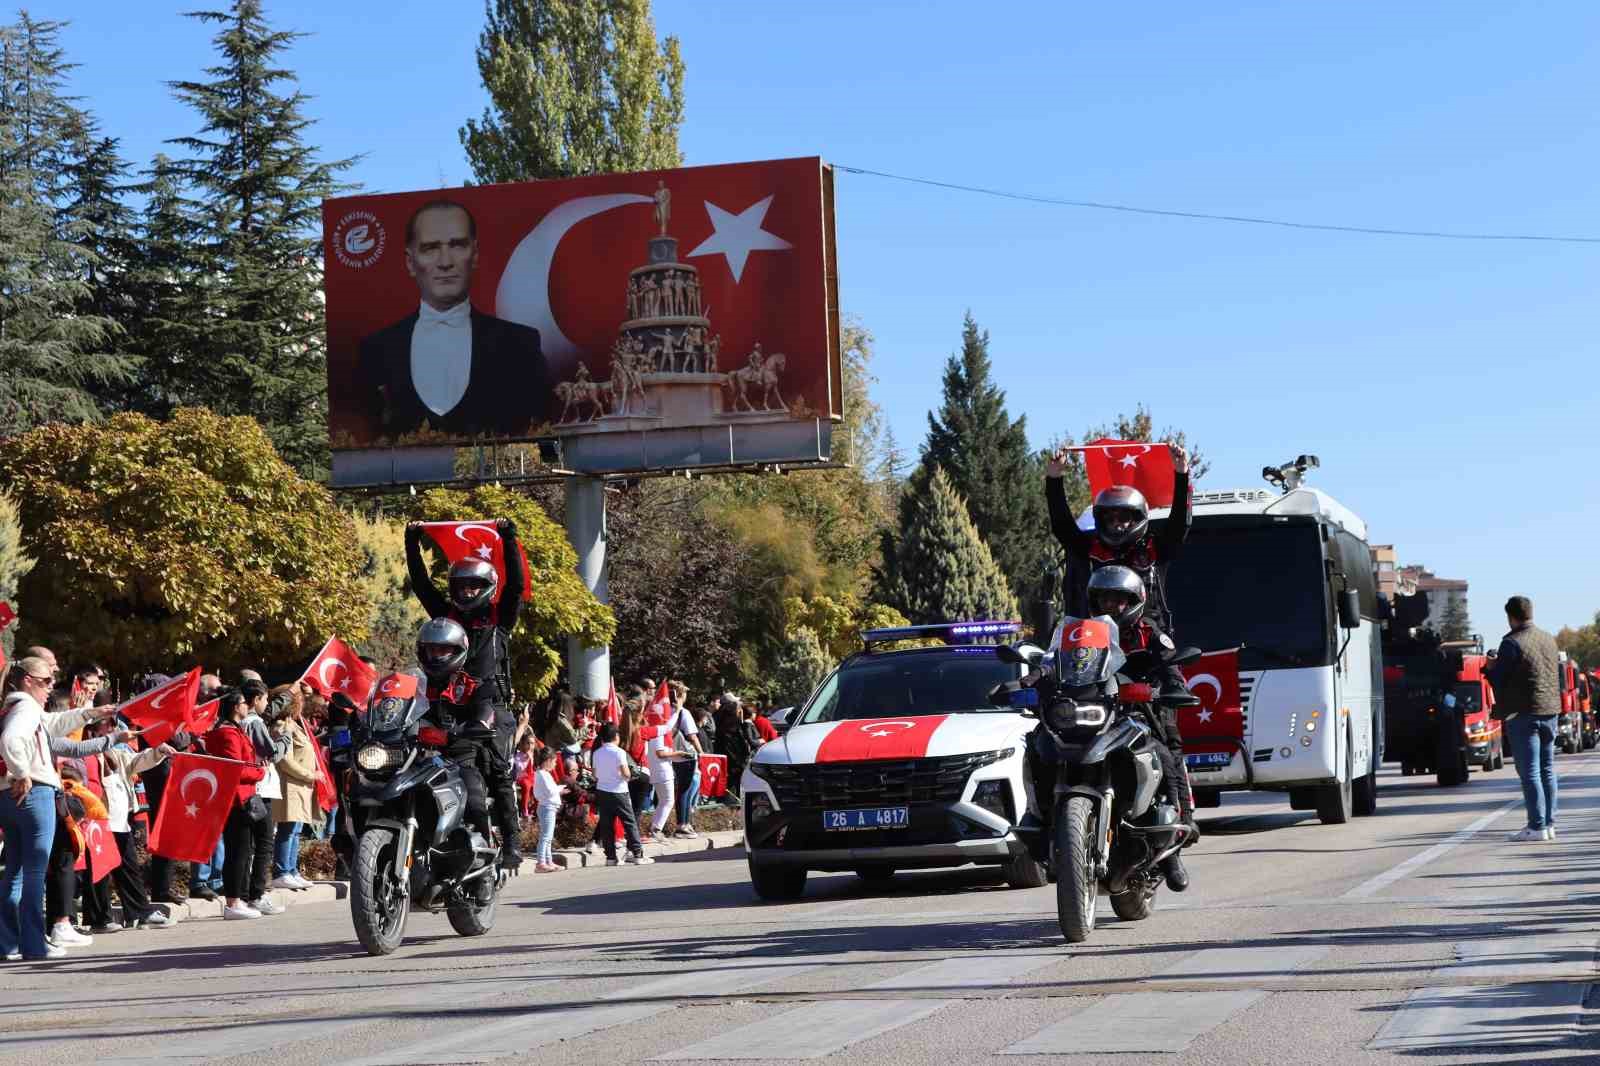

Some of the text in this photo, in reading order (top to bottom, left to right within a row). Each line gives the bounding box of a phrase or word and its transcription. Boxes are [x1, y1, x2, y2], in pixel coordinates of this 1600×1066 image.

[831, 809, 906, 826] 26 A 4817
